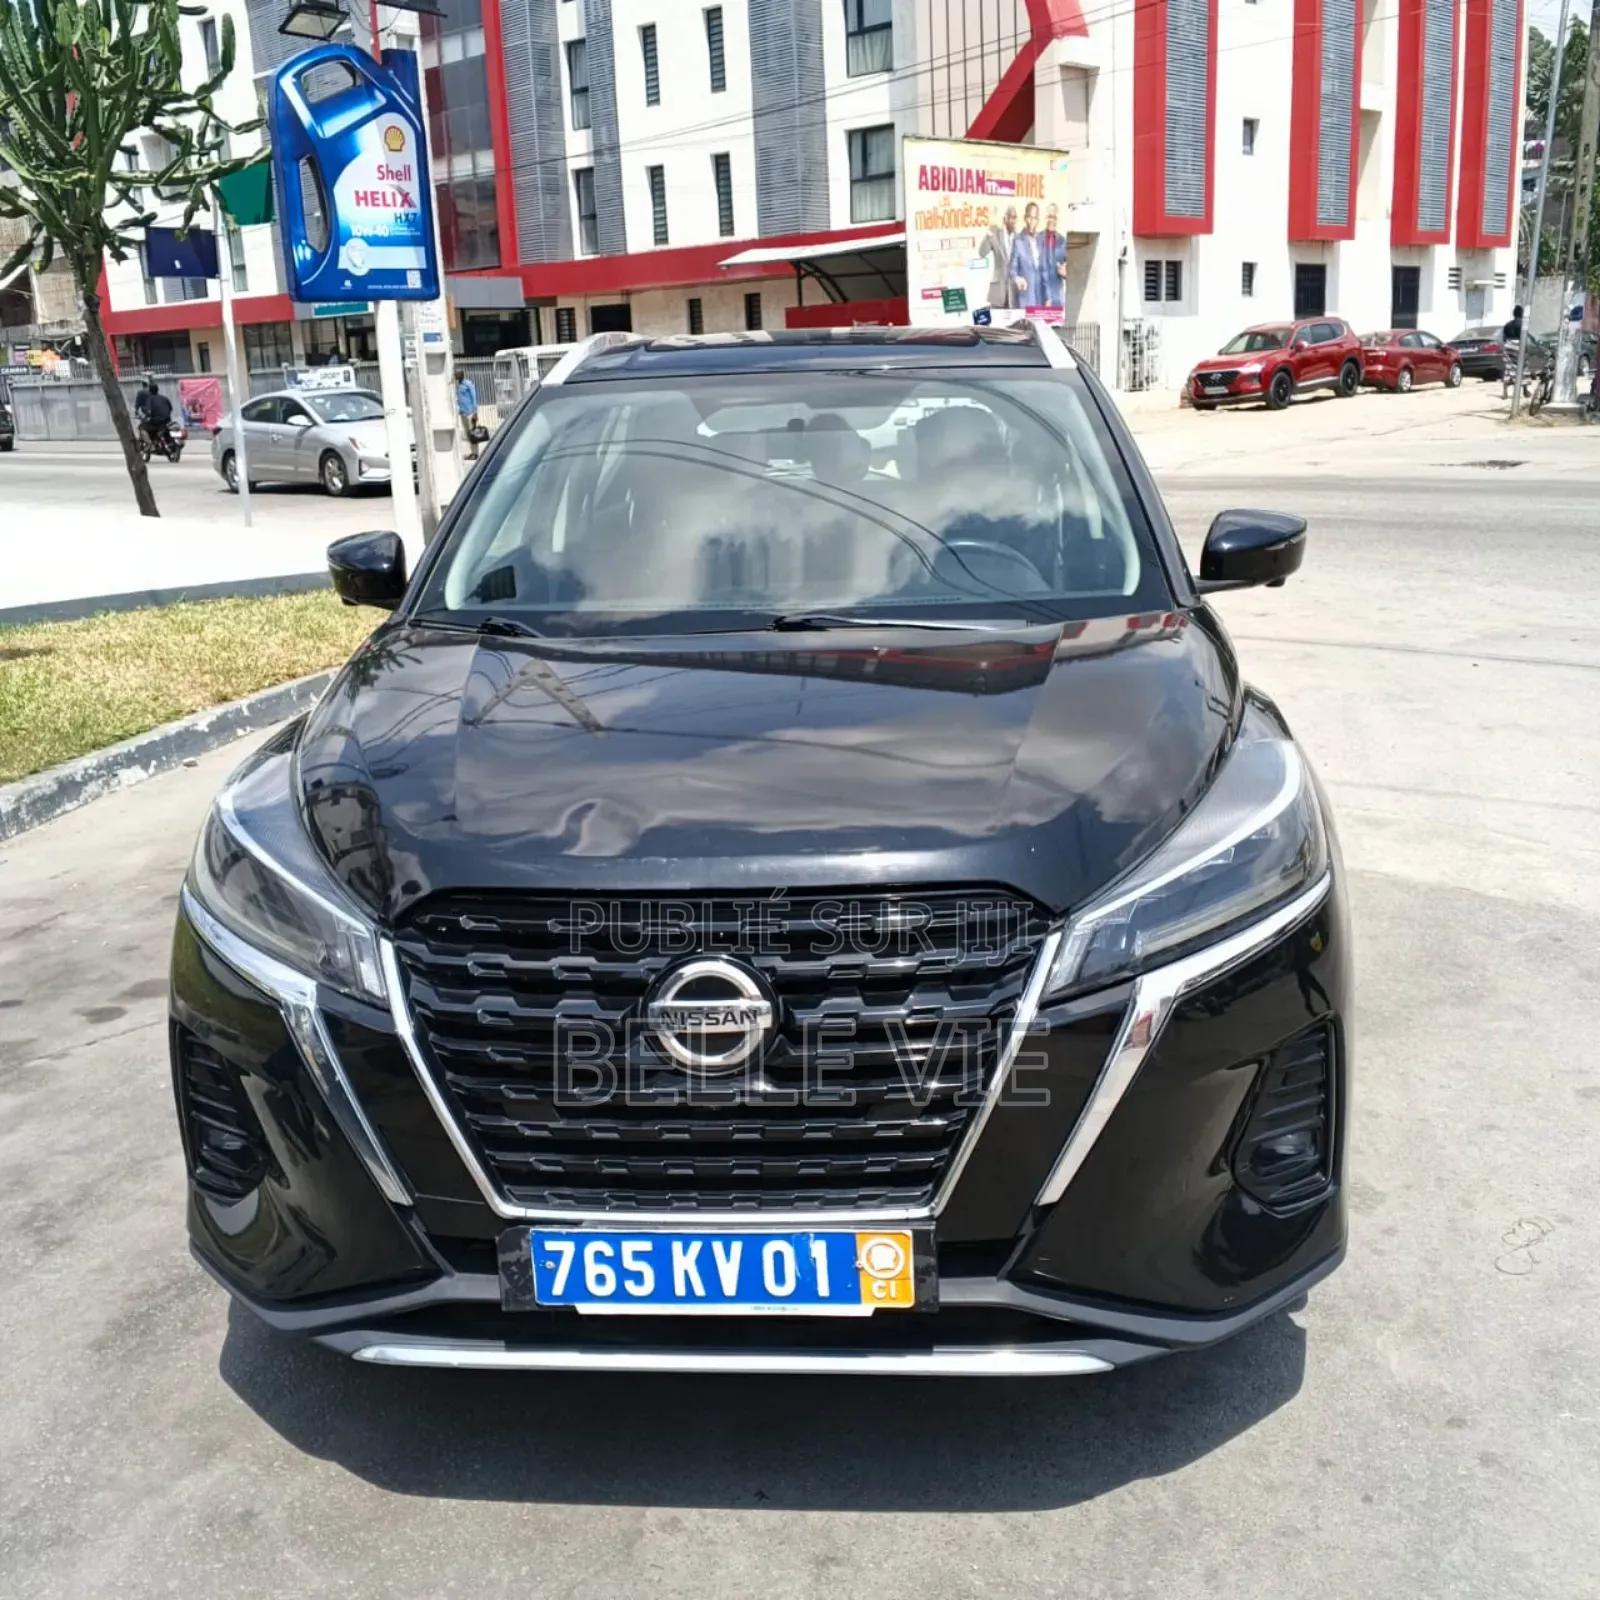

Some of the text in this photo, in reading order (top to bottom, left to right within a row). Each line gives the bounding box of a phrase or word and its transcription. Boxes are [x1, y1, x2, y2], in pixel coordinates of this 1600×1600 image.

[376, 163, 412, 182] Shell
[918, 164, 986, 195] ABIDJAN
[1016, 172, 1045, 200] RIRE
[354, 189, 417, 209] HELIX
[394, 212, 418, 224] HX7
[660, 1008, 759, 1029] NISSAN
[544, 1239, 830, 1298] 765 KV 01
[871, 1279, 897, 1300] CI
